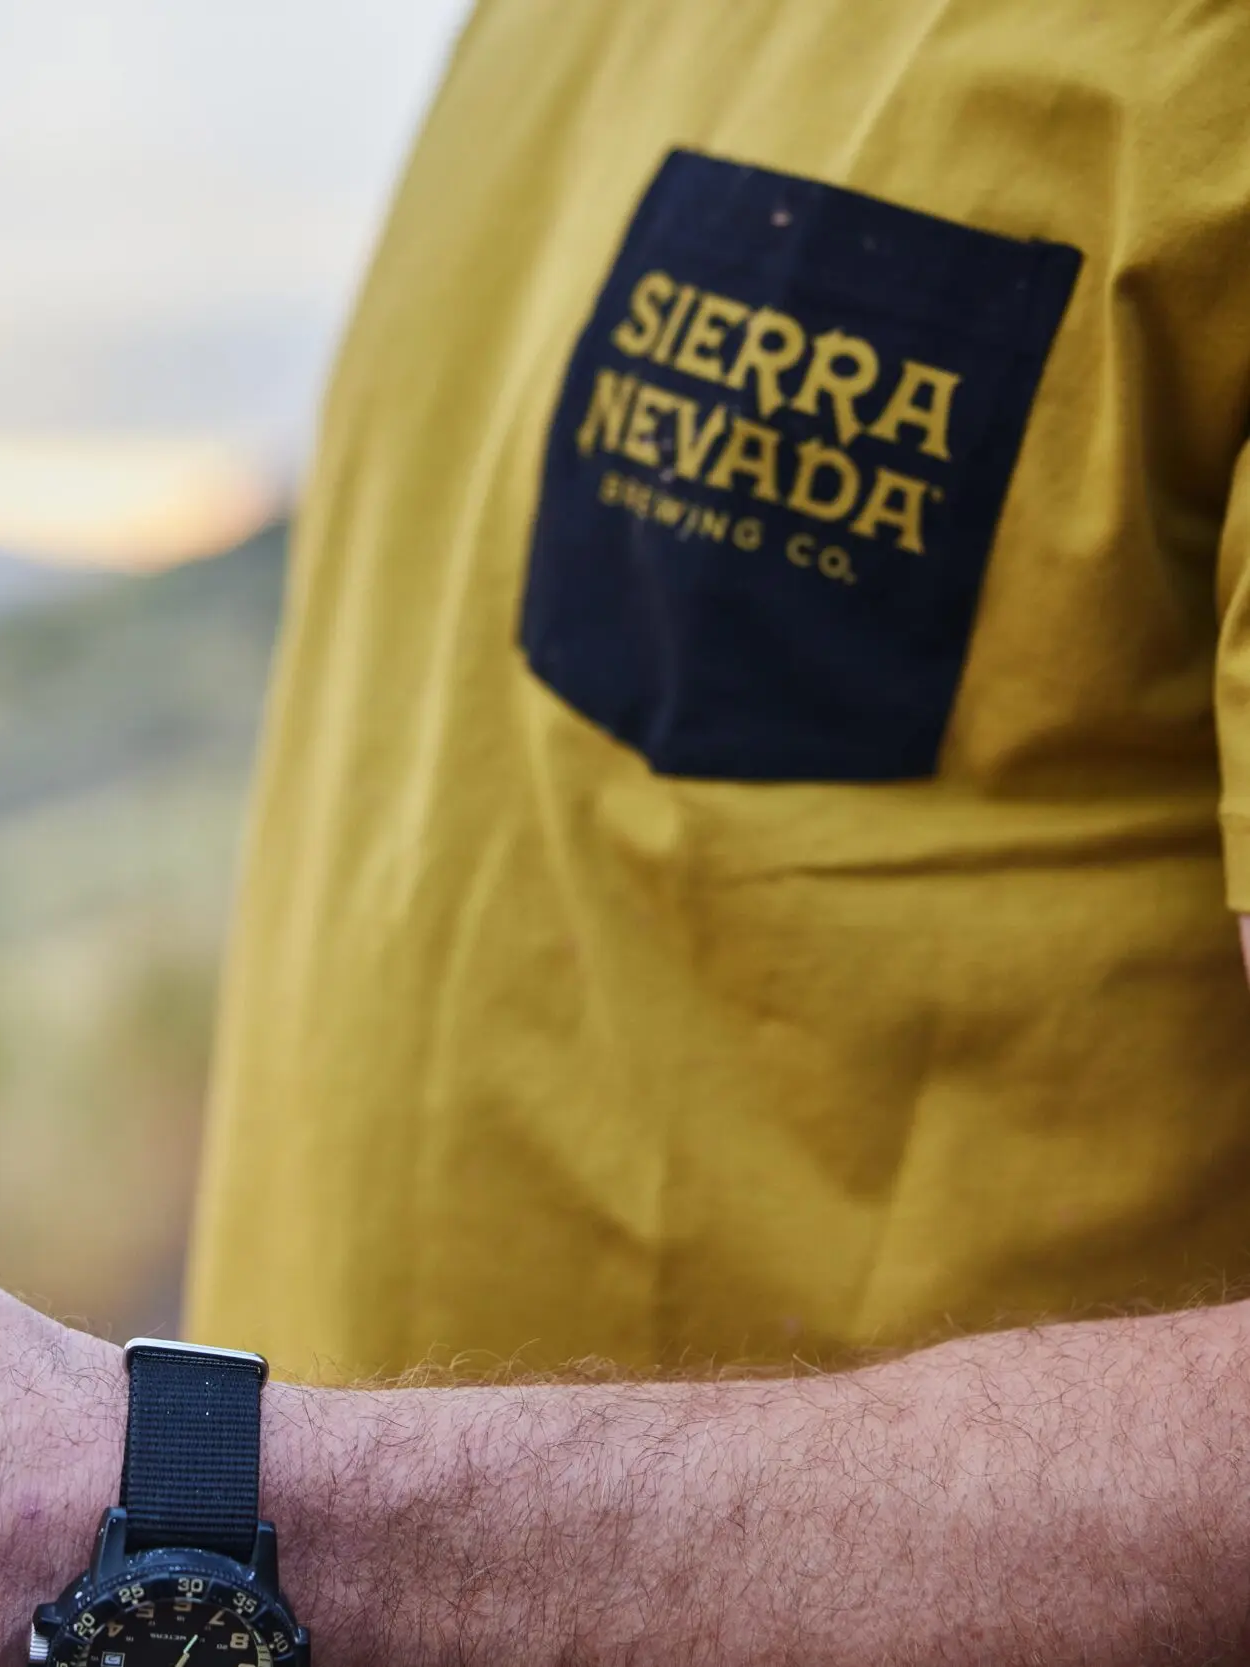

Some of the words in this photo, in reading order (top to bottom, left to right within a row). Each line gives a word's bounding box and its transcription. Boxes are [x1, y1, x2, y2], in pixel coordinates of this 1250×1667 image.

[612, 269, 961, 460] SIERRA
[577, 368, 929, 555] NEVADA
[785, 531, 857, 585] CO.
[119, 1583, 144, 1603] 25
[178, 1578, 203, 1593] 30
[233, 1592, 257, 1613] 35
[73, 1612, 95, 1636] 20
[230, 1632, 250, 1649] 8
[273, 1631, 288, 1652] 40
